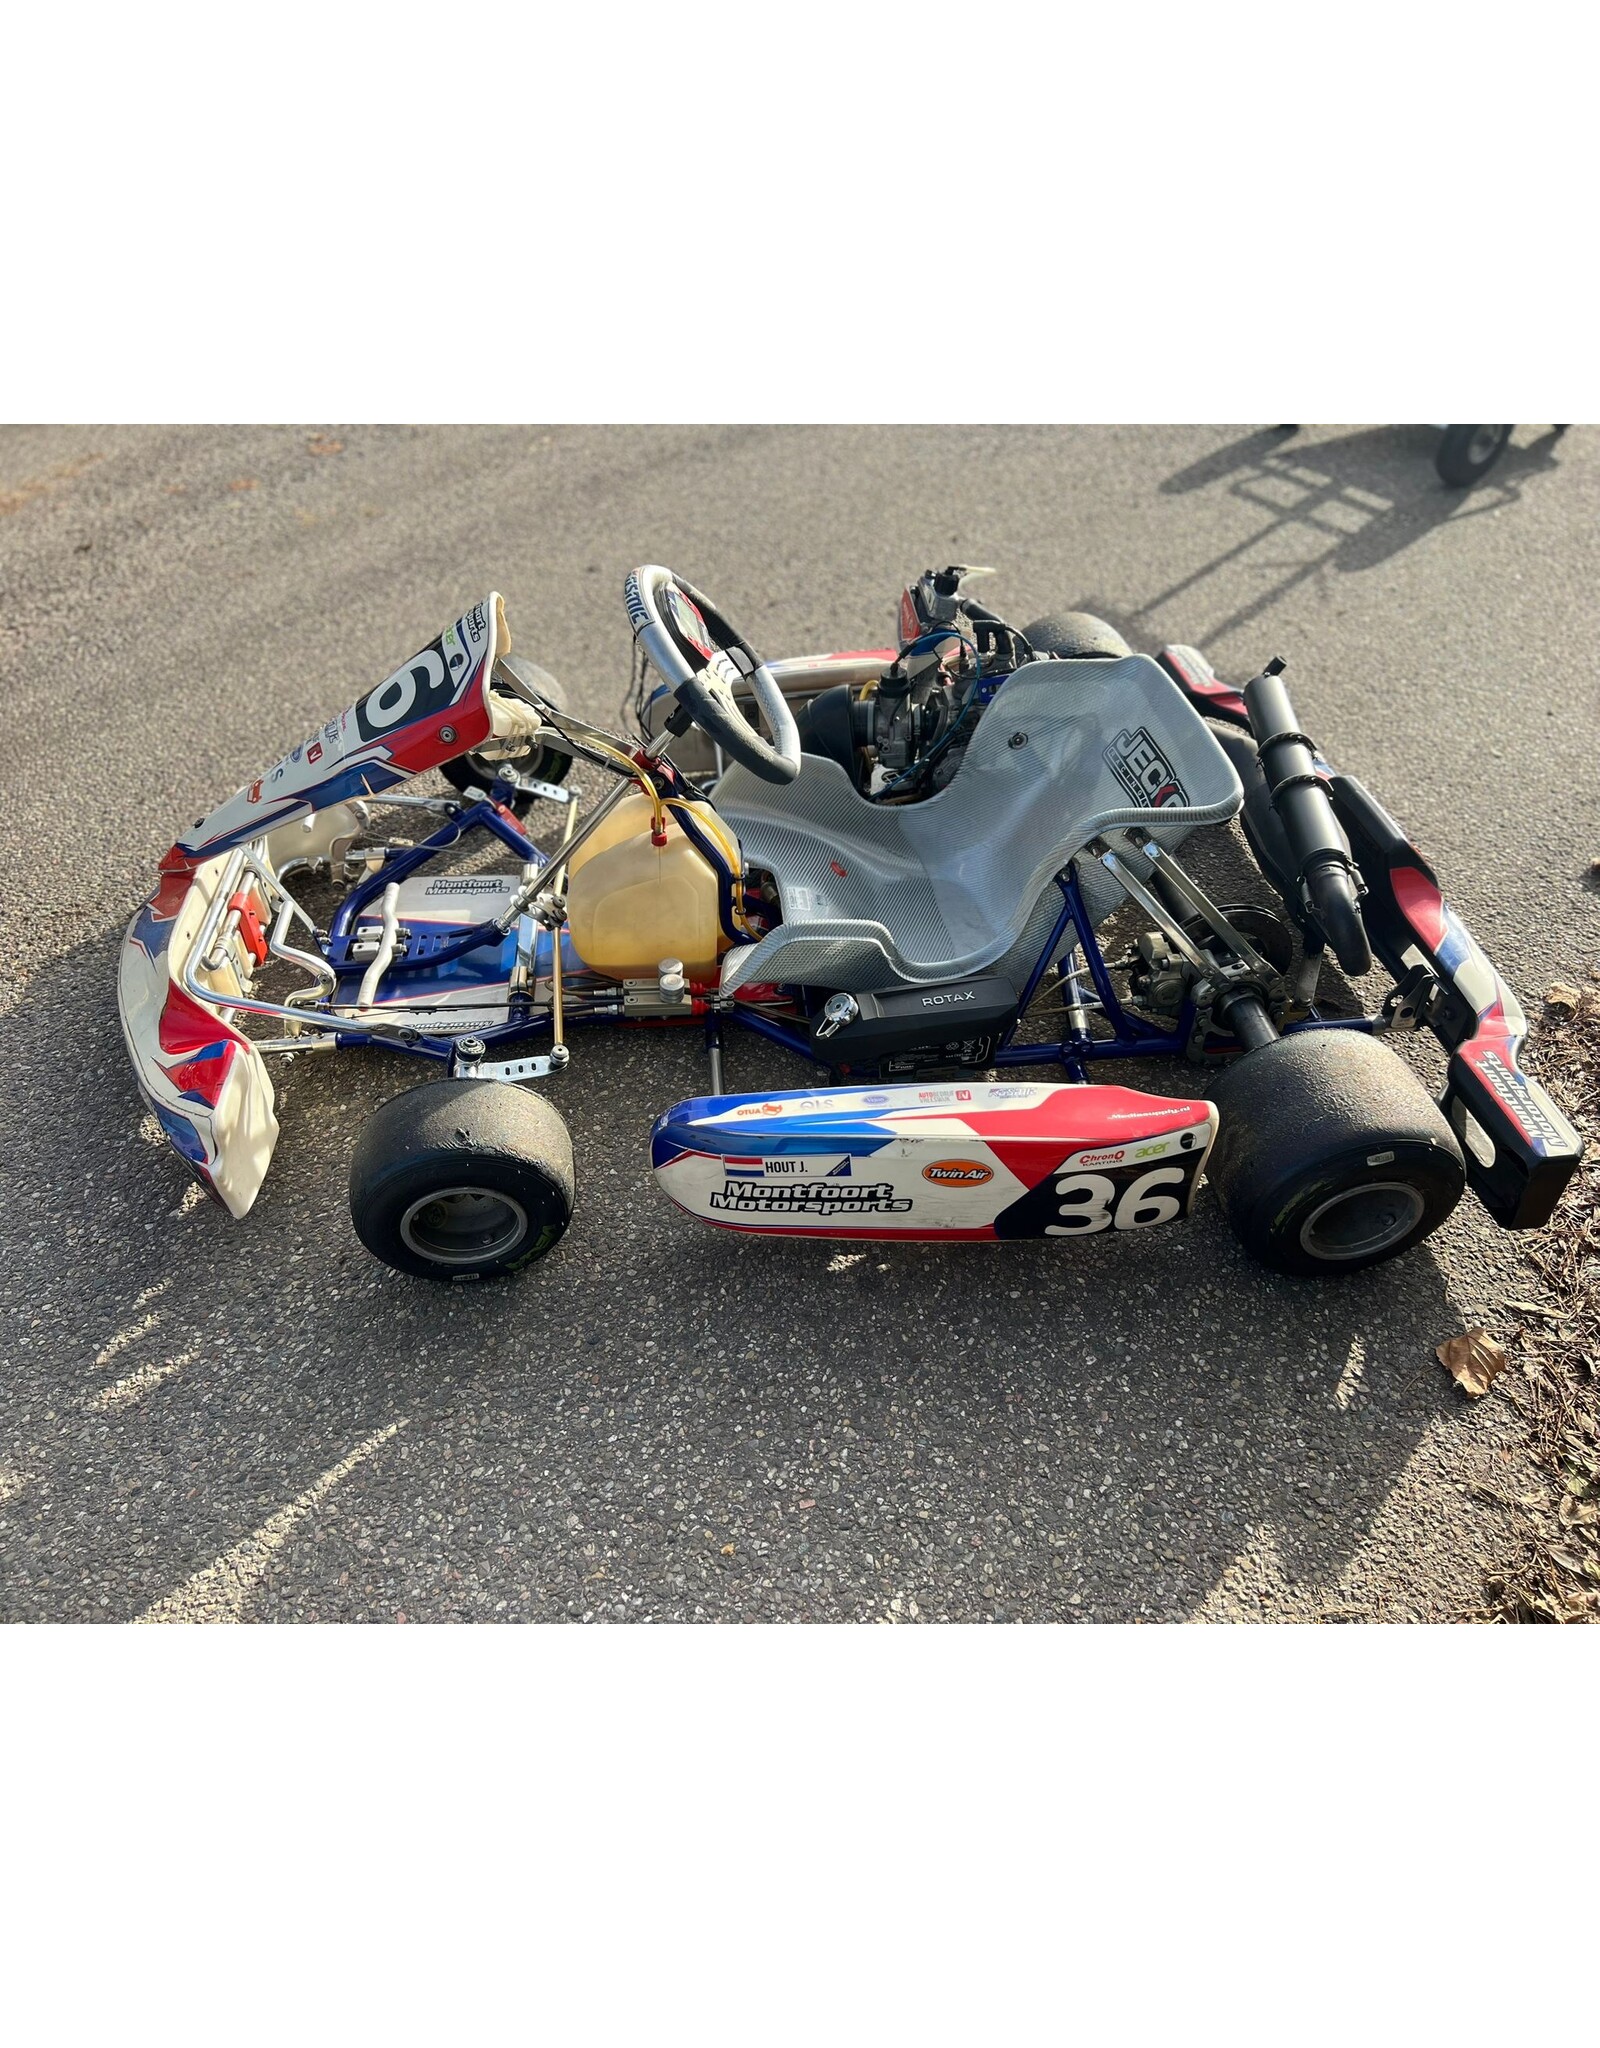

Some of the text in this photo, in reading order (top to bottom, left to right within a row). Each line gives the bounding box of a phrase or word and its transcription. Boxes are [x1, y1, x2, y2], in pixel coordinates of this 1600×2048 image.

[366, 649, 445, 728] 6
[425, 886, 510, 895] Motorsports
[433, 880, 503, 888] Montfoort
[921, 990, 976, 1007] ROTAX
[1475, 1059, 1545, 1138] Montfoort
[1481, 1050, 1568, 1147] Motorsports
[1135, 1142, 1170, 1159] acer
[765, 1161, 809, 1173] HOUT J.
[1082, 1159, 1123, 1167] KARTING
[929, 1168, 989, 1180] Twin Air
[727, 1181, 893, 1199] Montfoort
[711, 1193, 912, 1215] Motorsports
[1045, 1167, 1185, 1236] 36
